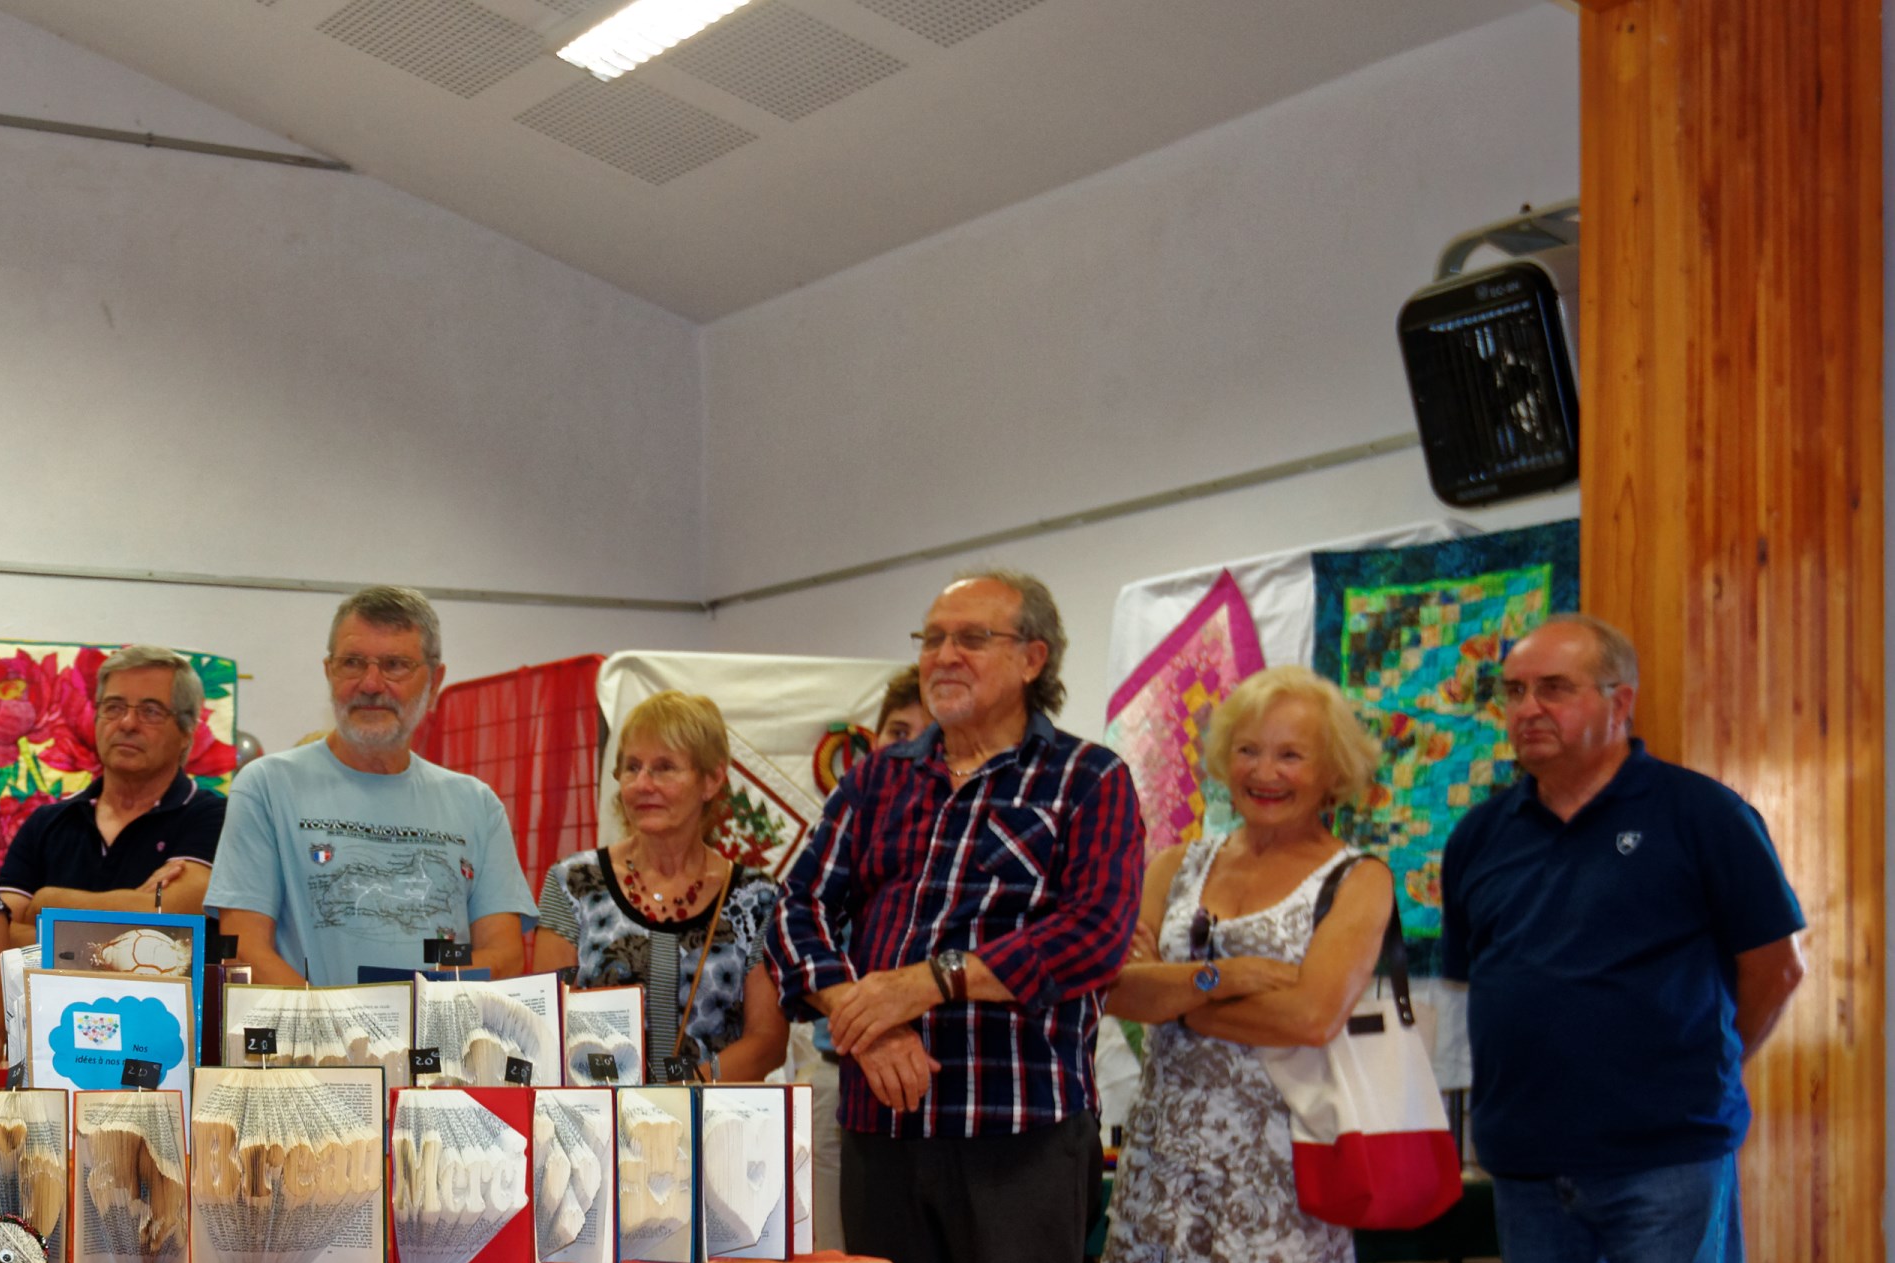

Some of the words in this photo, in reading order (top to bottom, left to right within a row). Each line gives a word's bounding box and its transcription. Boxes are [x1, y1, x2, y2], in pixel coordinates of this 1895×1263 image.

[132, 1044, 148, 1053] Nos
[75, 1055, 96, 1064] idées
[98, 1056, 103, 1064] à
